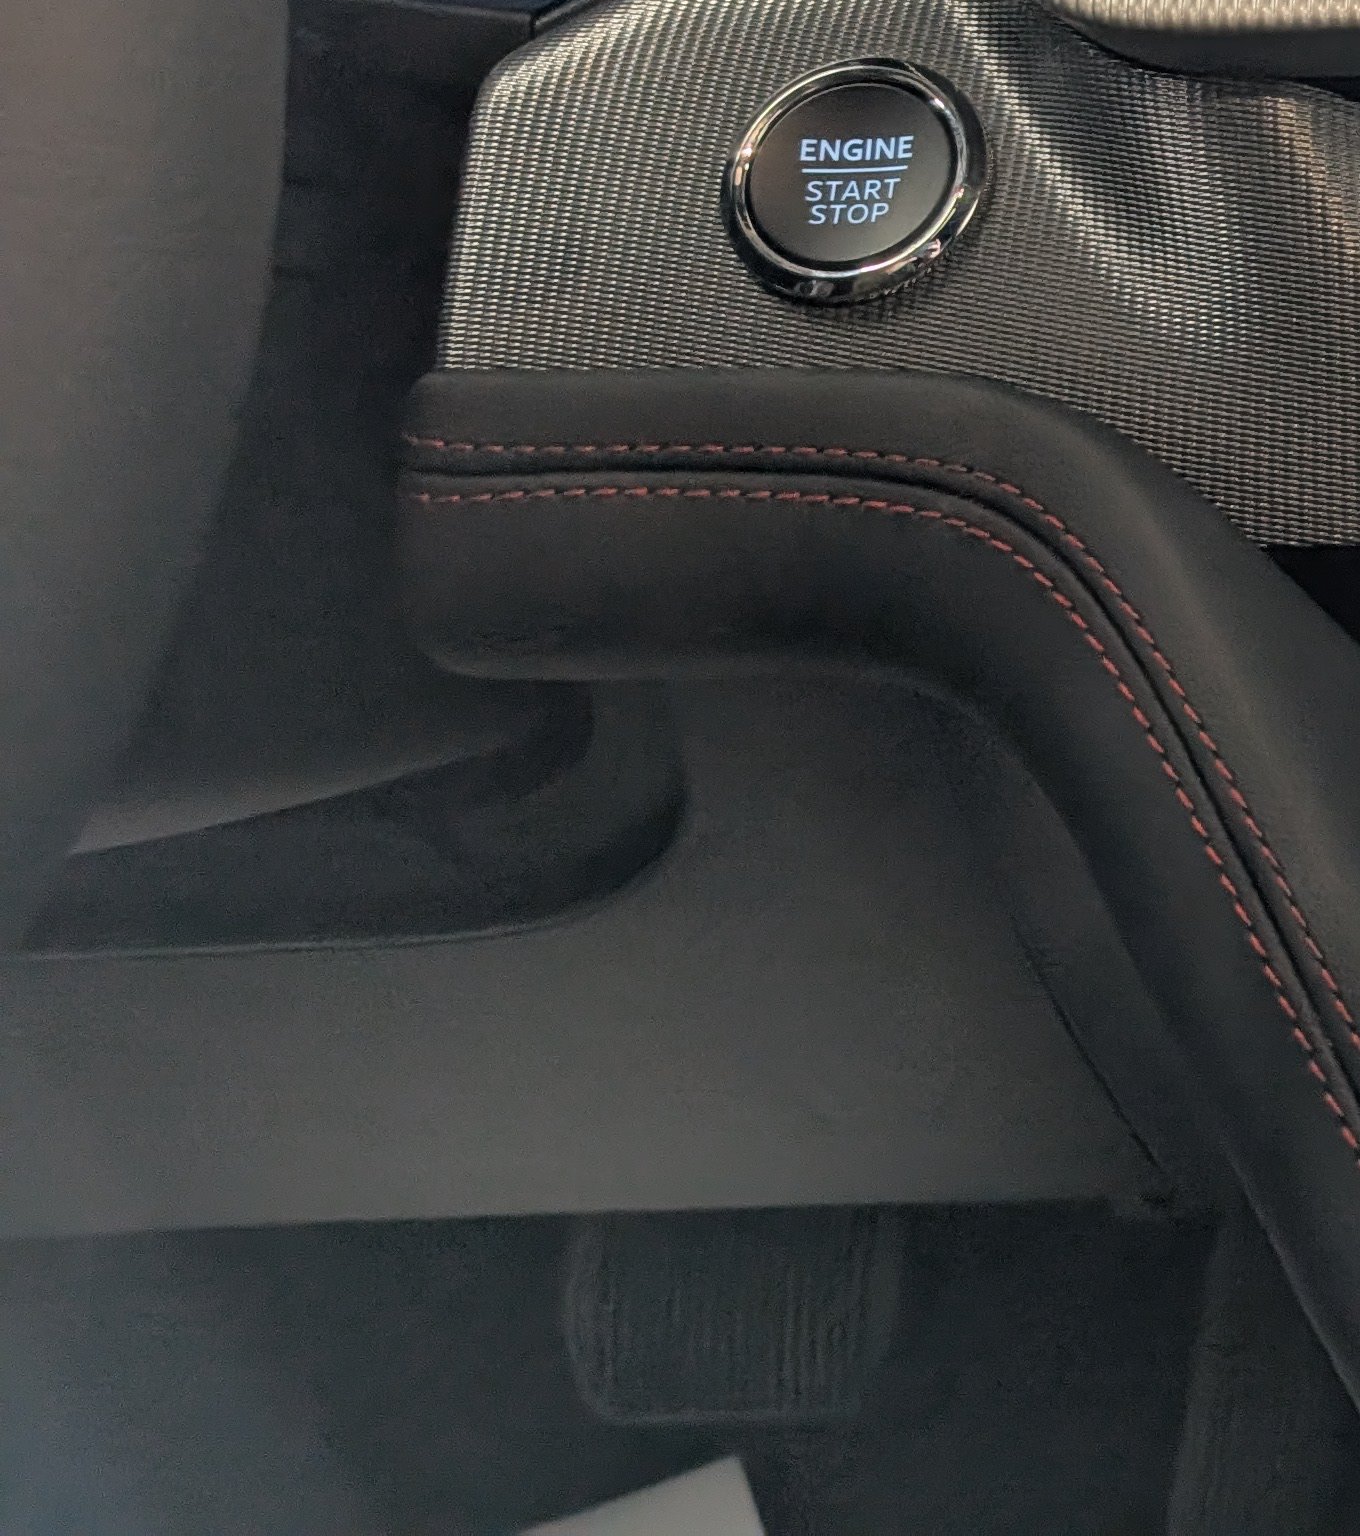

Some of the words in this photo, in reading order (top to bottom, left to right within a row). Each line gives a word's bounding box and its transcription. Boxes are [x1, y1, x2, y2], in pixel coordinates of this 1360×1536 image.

[799, 135, 914, 162] ENGINE
[804, 177, 902, 203] START
[808, 202, 890, 225] STOP
